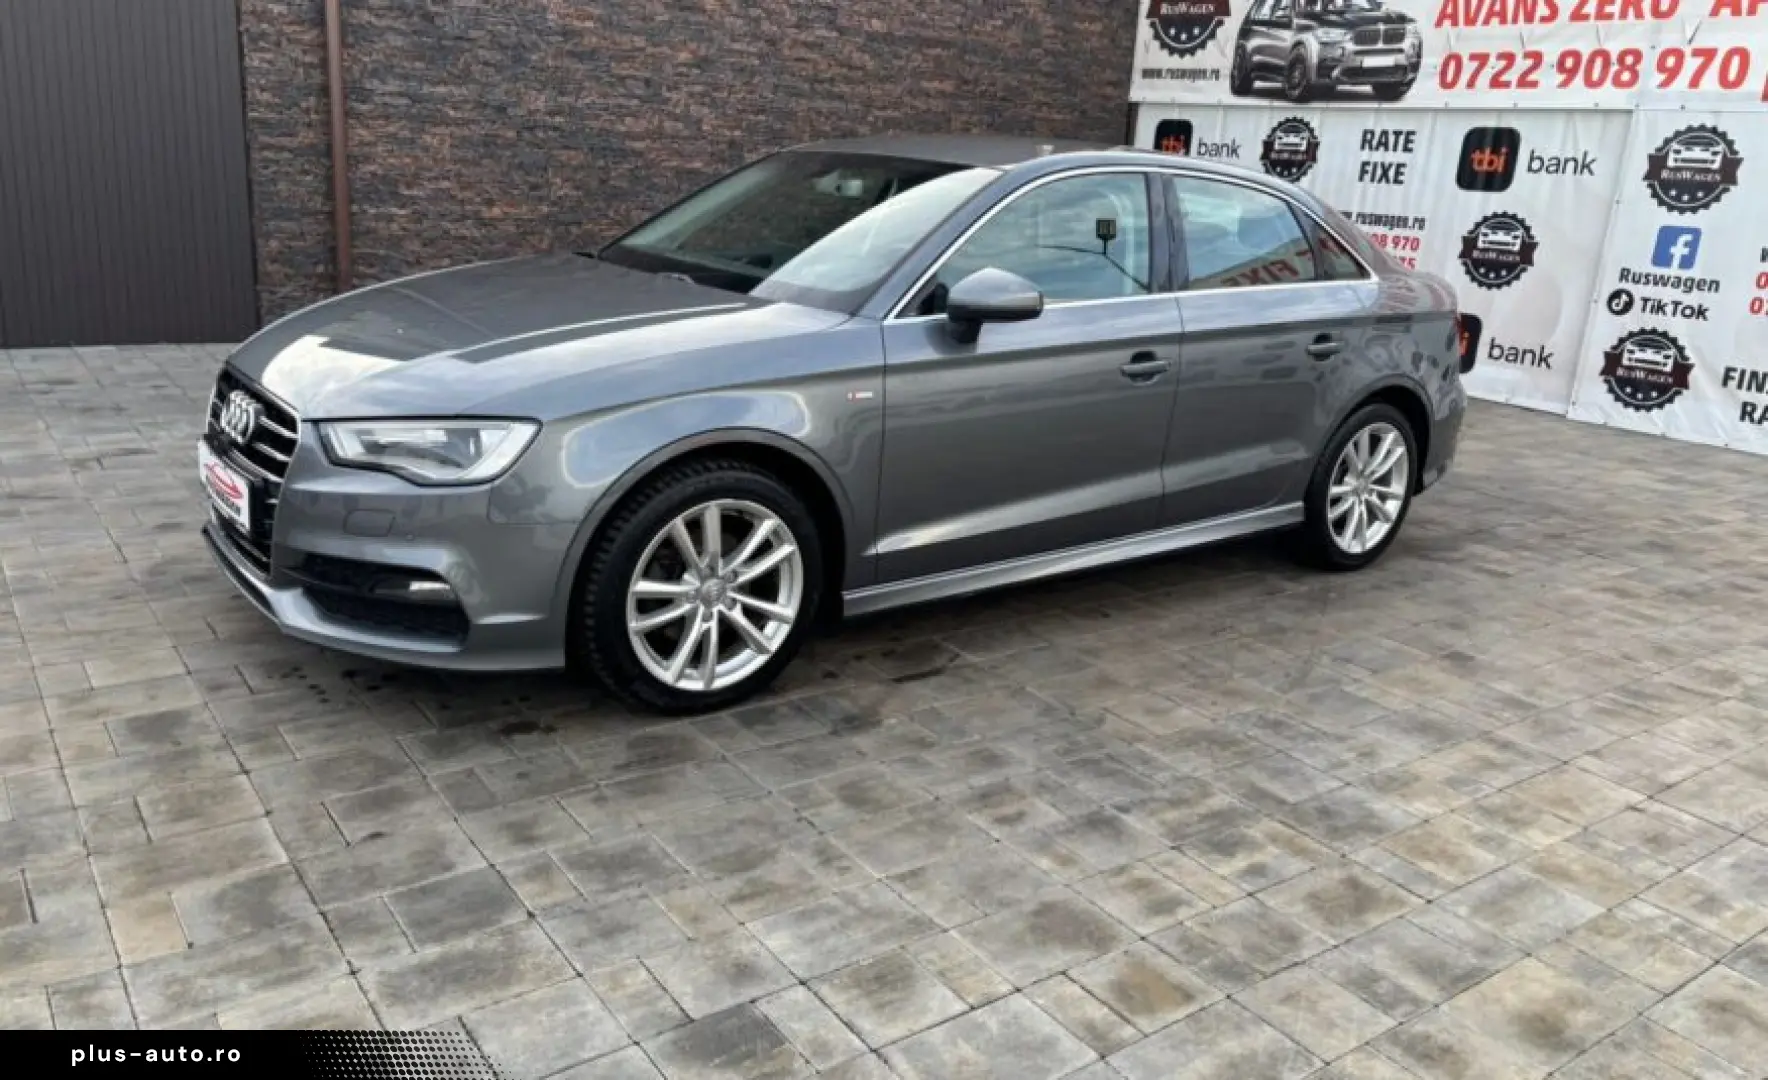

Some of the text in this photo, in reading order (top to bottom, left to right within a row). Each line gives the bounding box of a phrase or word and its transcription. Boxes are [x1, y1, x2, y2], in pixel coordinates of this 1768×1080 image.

[1434, 0, 1560, 29] AVANS
[1438, 52, 1544, 90] 0722
[1555, 48, 1643, 89] 908
[1656, 46, 1751, 89] 970
[1197, 137, 1240, 159] bank
[1360, 128, 1417, 153] RATE
[1357, 160, 1407, 185] FIXE
[1471, 147, 1598, 177] tbi bank
[1618, 267, 1720, 293] Ruswagen
[1640, 296, 1709, 321] TikTok
[1487, 337, 1554, 370] bank
[1721, 365, 1768, 396] FIN
